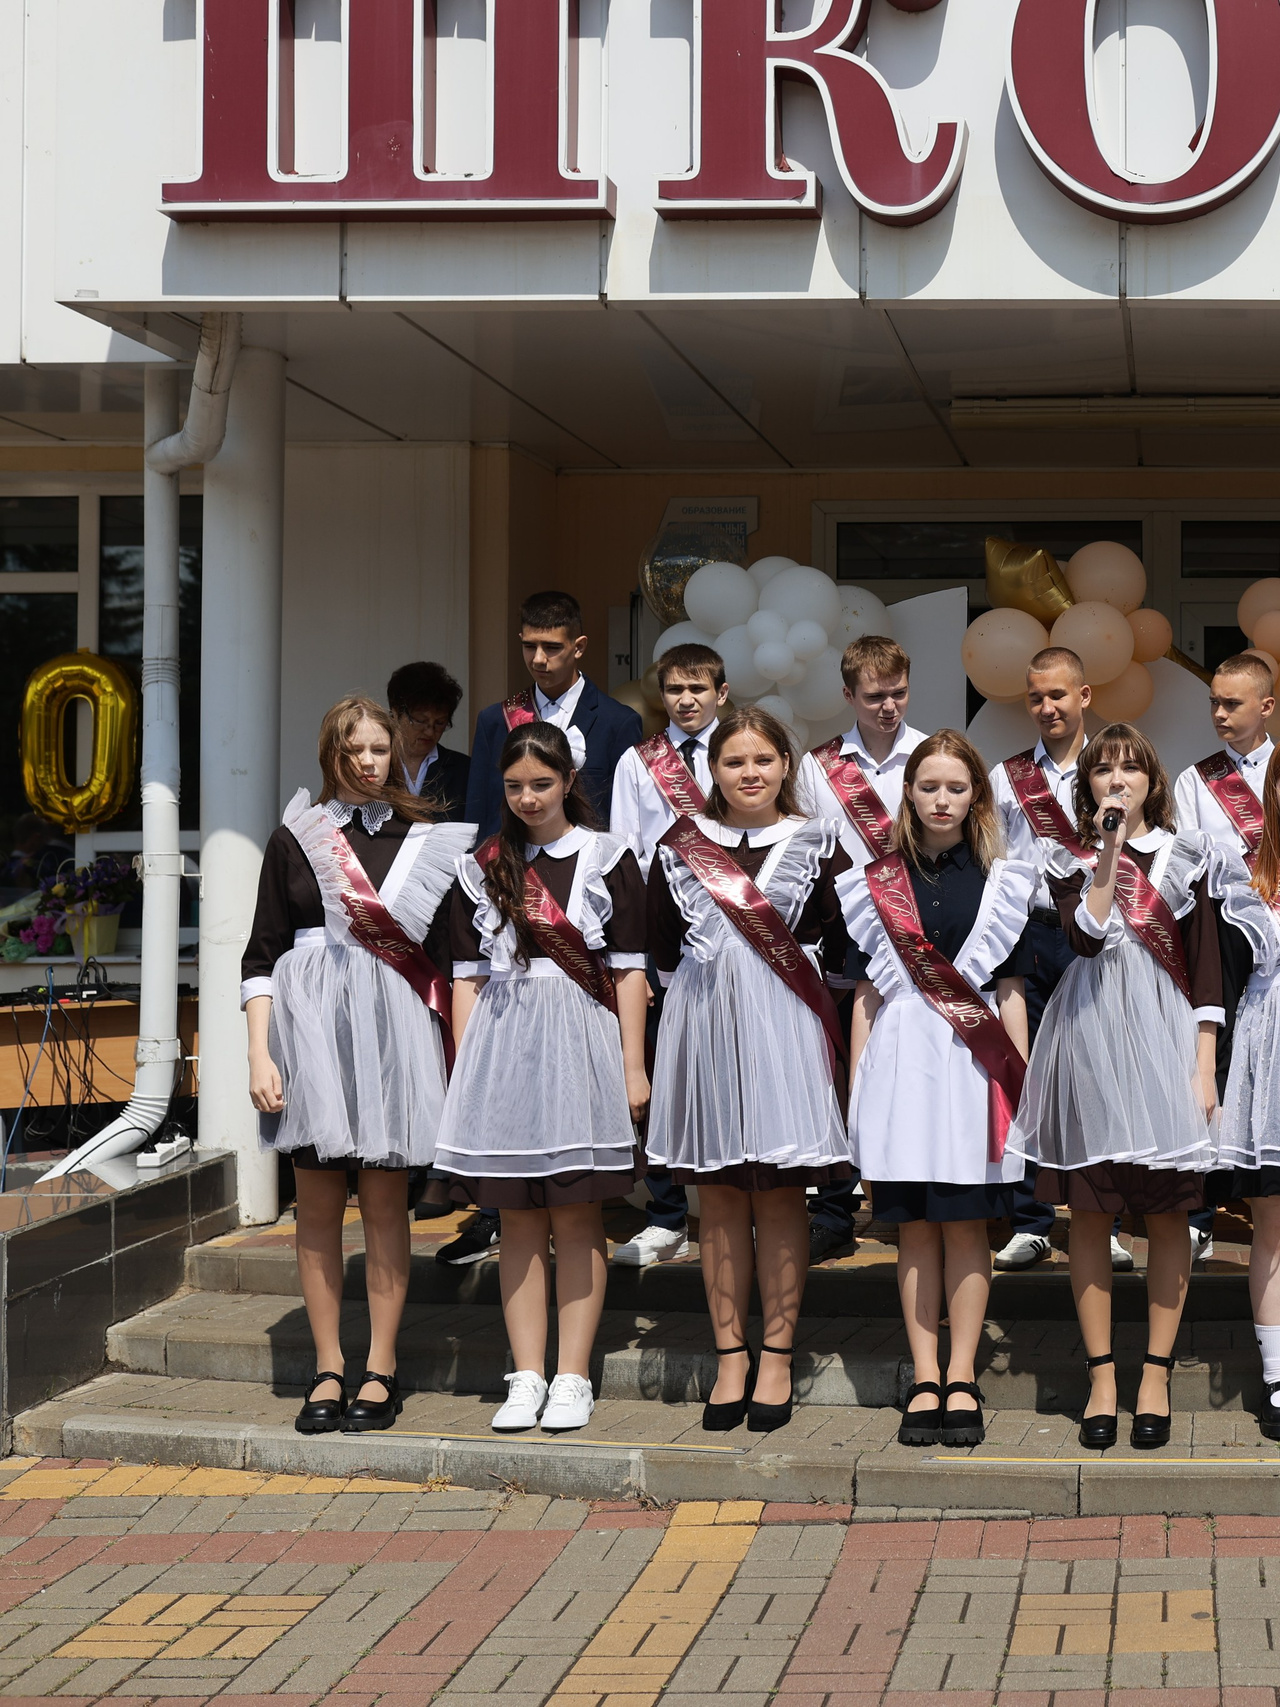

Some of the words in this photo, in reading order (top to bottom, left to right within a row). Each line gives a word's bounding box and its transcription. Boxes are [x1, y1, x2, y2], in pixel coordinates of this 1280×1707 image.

[681, 506, 747, 515] ОБРАЗОВАНИЕ
[768, 940, 803, 972] 2025
[947, 997, 990, 1029] 2025
